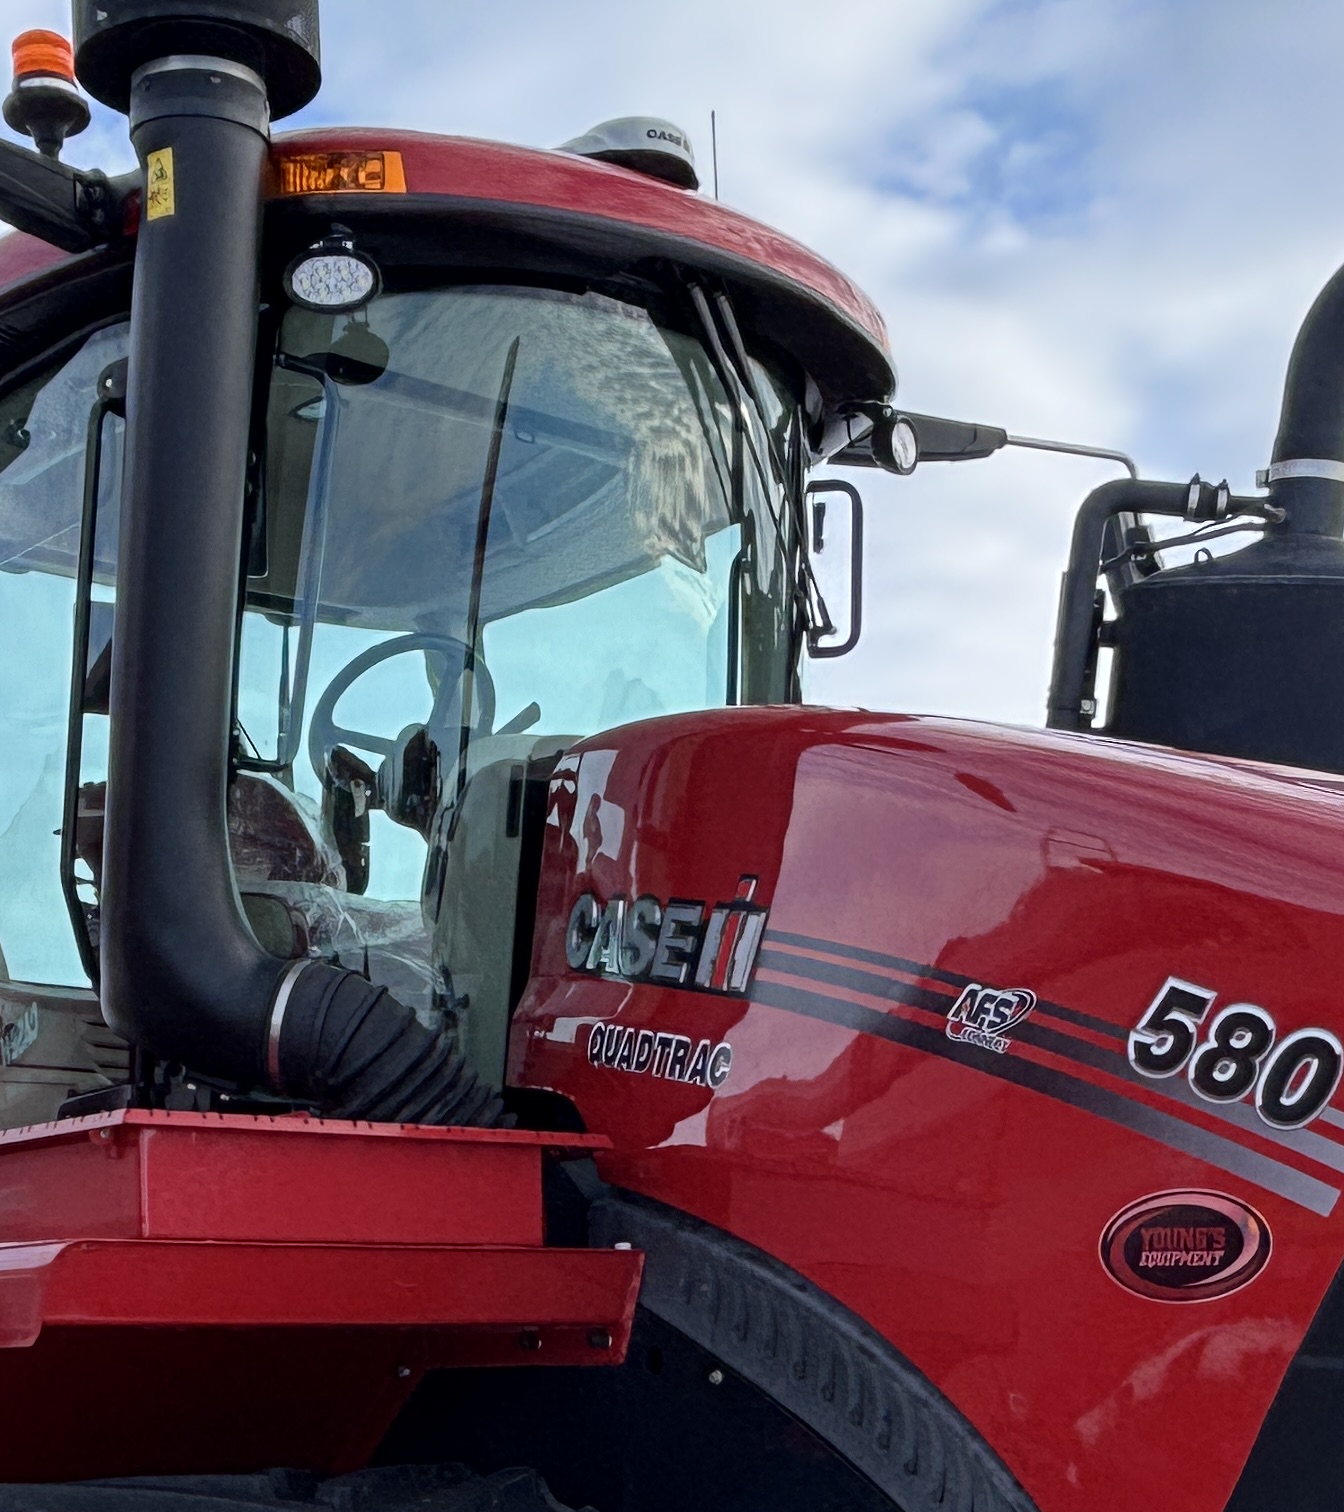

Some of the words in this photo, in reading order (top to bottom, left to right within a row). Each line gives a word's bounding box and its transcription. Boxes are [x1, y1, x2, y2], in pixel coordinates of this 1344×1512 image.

[565, 893, 706, 984] CASE
[947, 983, 1020, 1032] AFS
[588, 1021, 733, 1089] QUADTRAC
[1128, 976, 1344, 1130] 580
[1139, 1250, 1226, 1268] EQUIPMENT
[1140, 1227, 1227, 1250] YOUNG'S
